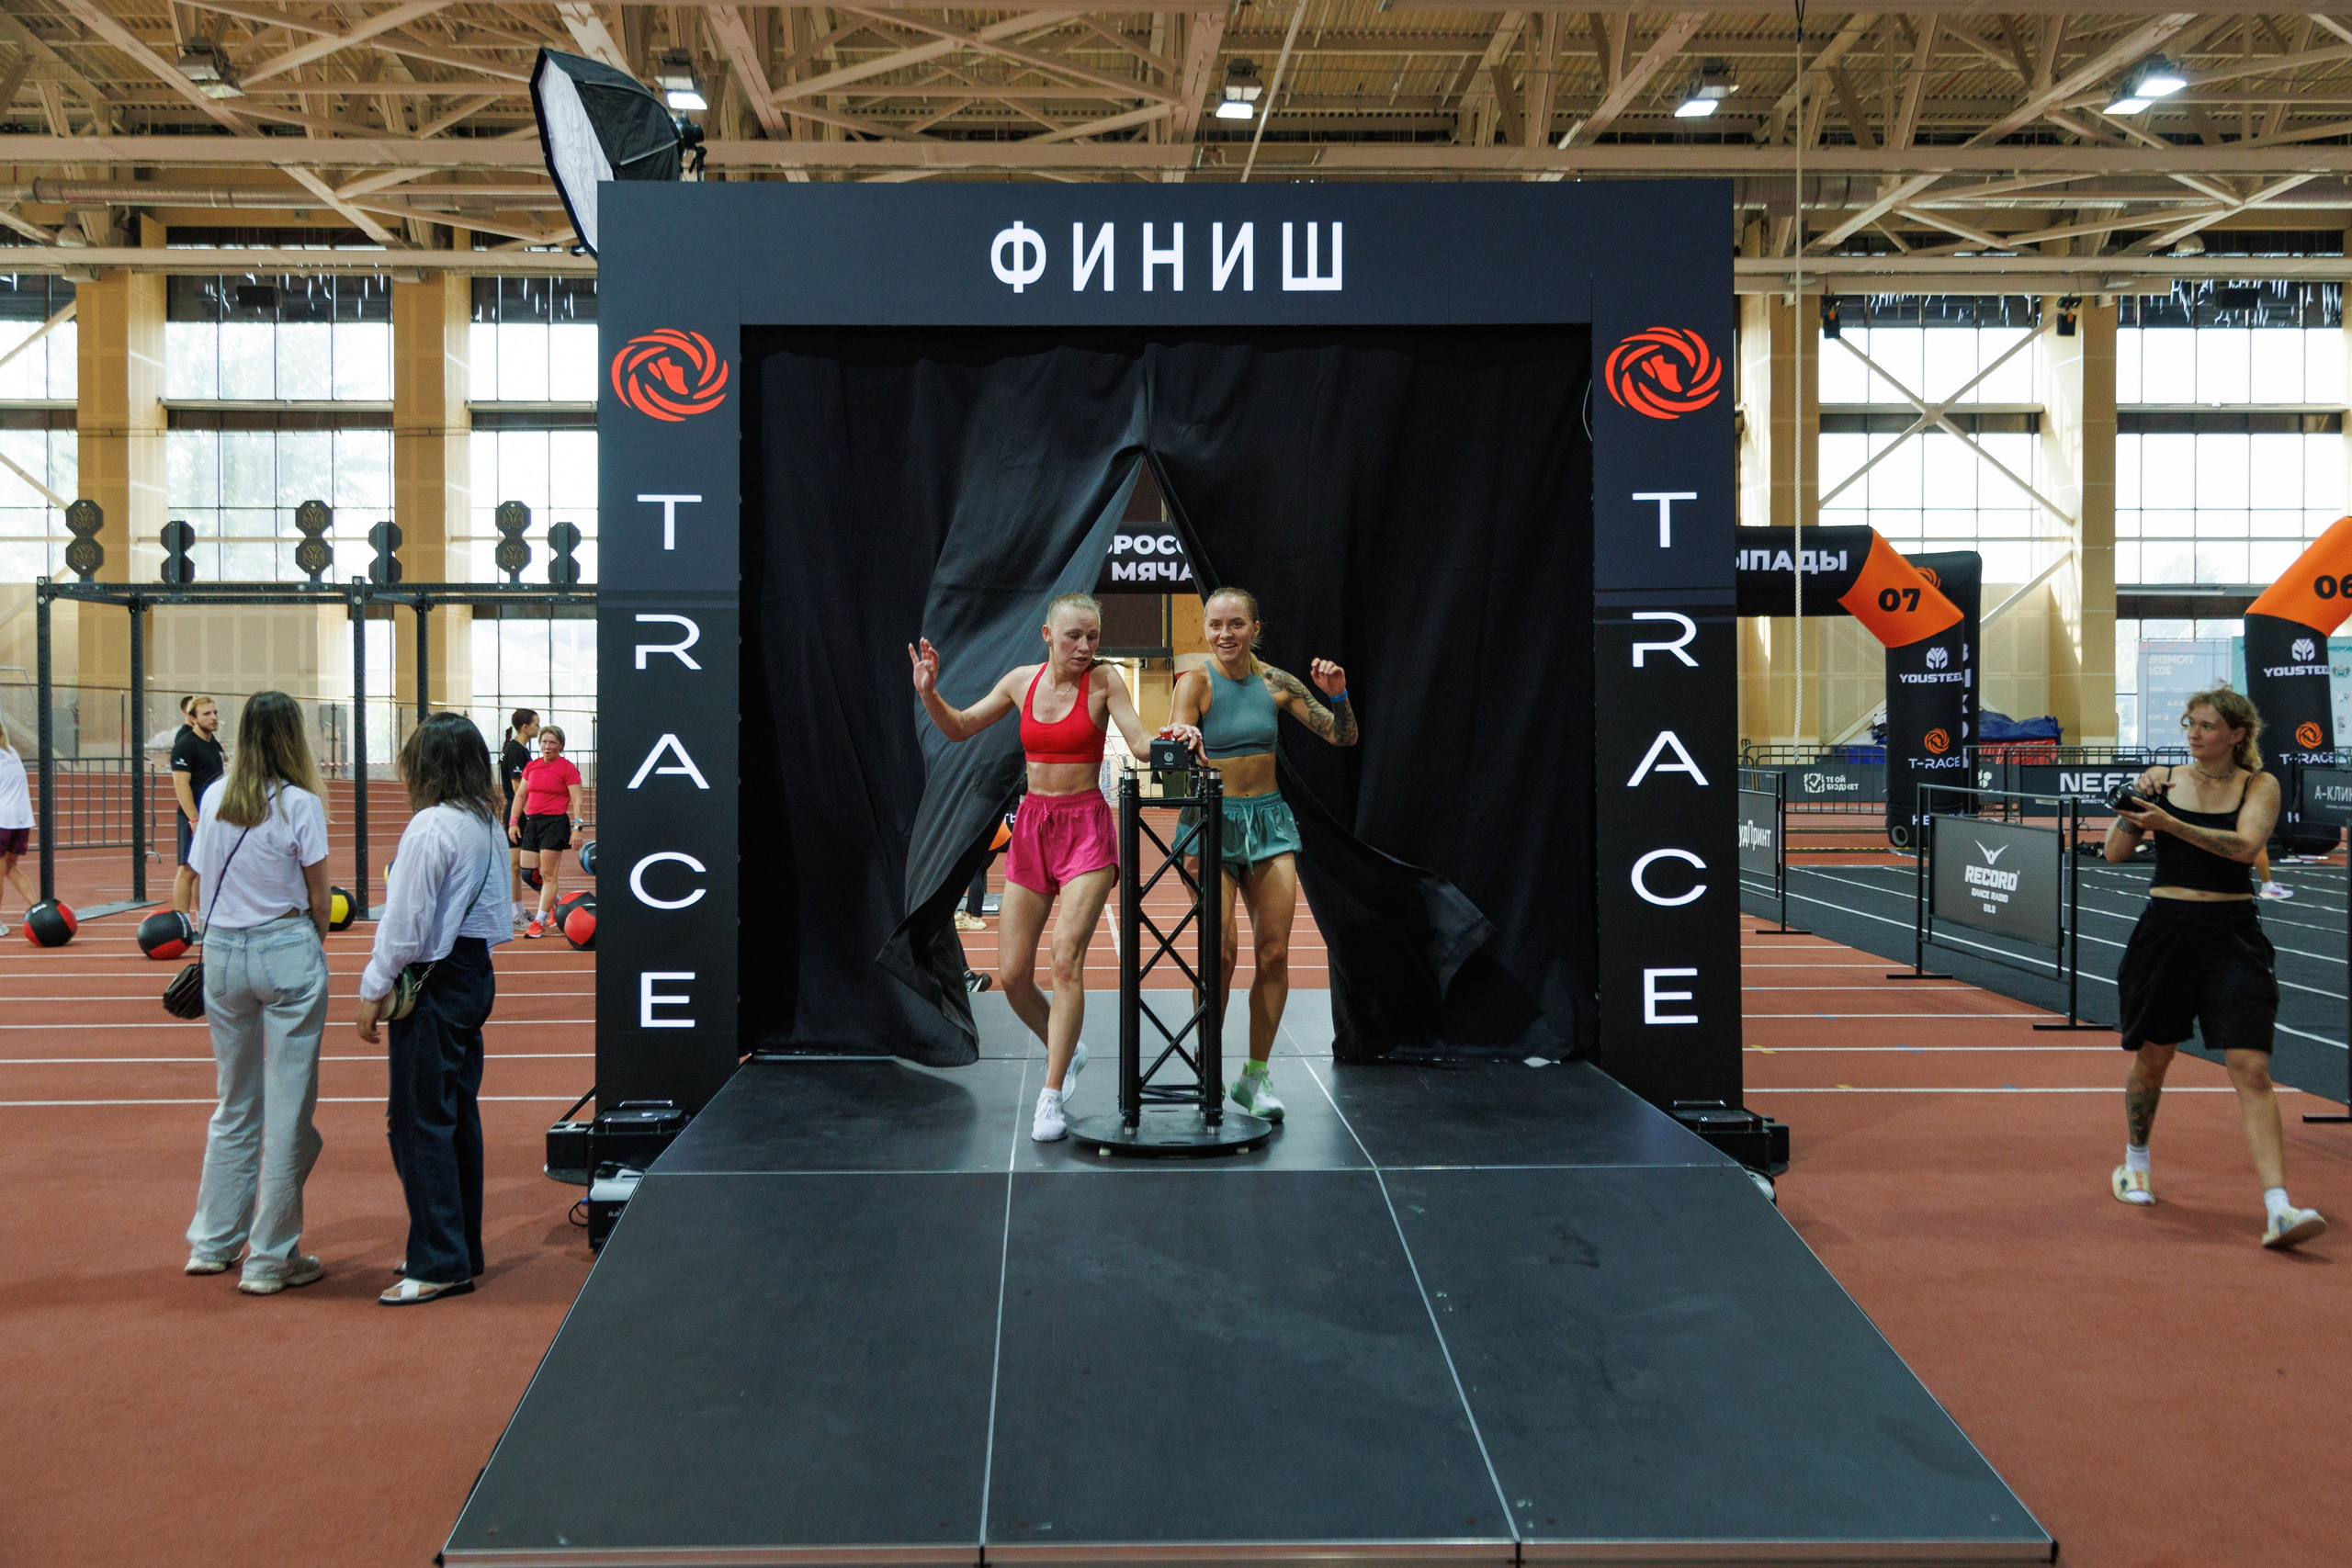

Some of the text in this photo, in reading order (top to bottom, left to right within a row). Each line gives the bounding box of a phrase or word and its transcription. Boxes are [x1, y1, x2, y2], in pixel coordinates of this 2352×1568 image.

[991, 221, 1343, 293] ФИНИШ
[1107, 535, 1184, 555] РОС
[1112, 561, 1193, 581] МЯЧА
[1878, 588, 1920, 612] 07
[1899, 671, 1963, 683] YOUSTEEL
[1908, 756, 1961, 769] T-RACE
[1739, 819, 1771, 852] удПринт
[1964, 864, 2018, 892] RECORD
[1971, 887, 2009, 903] DANCE RADIO
